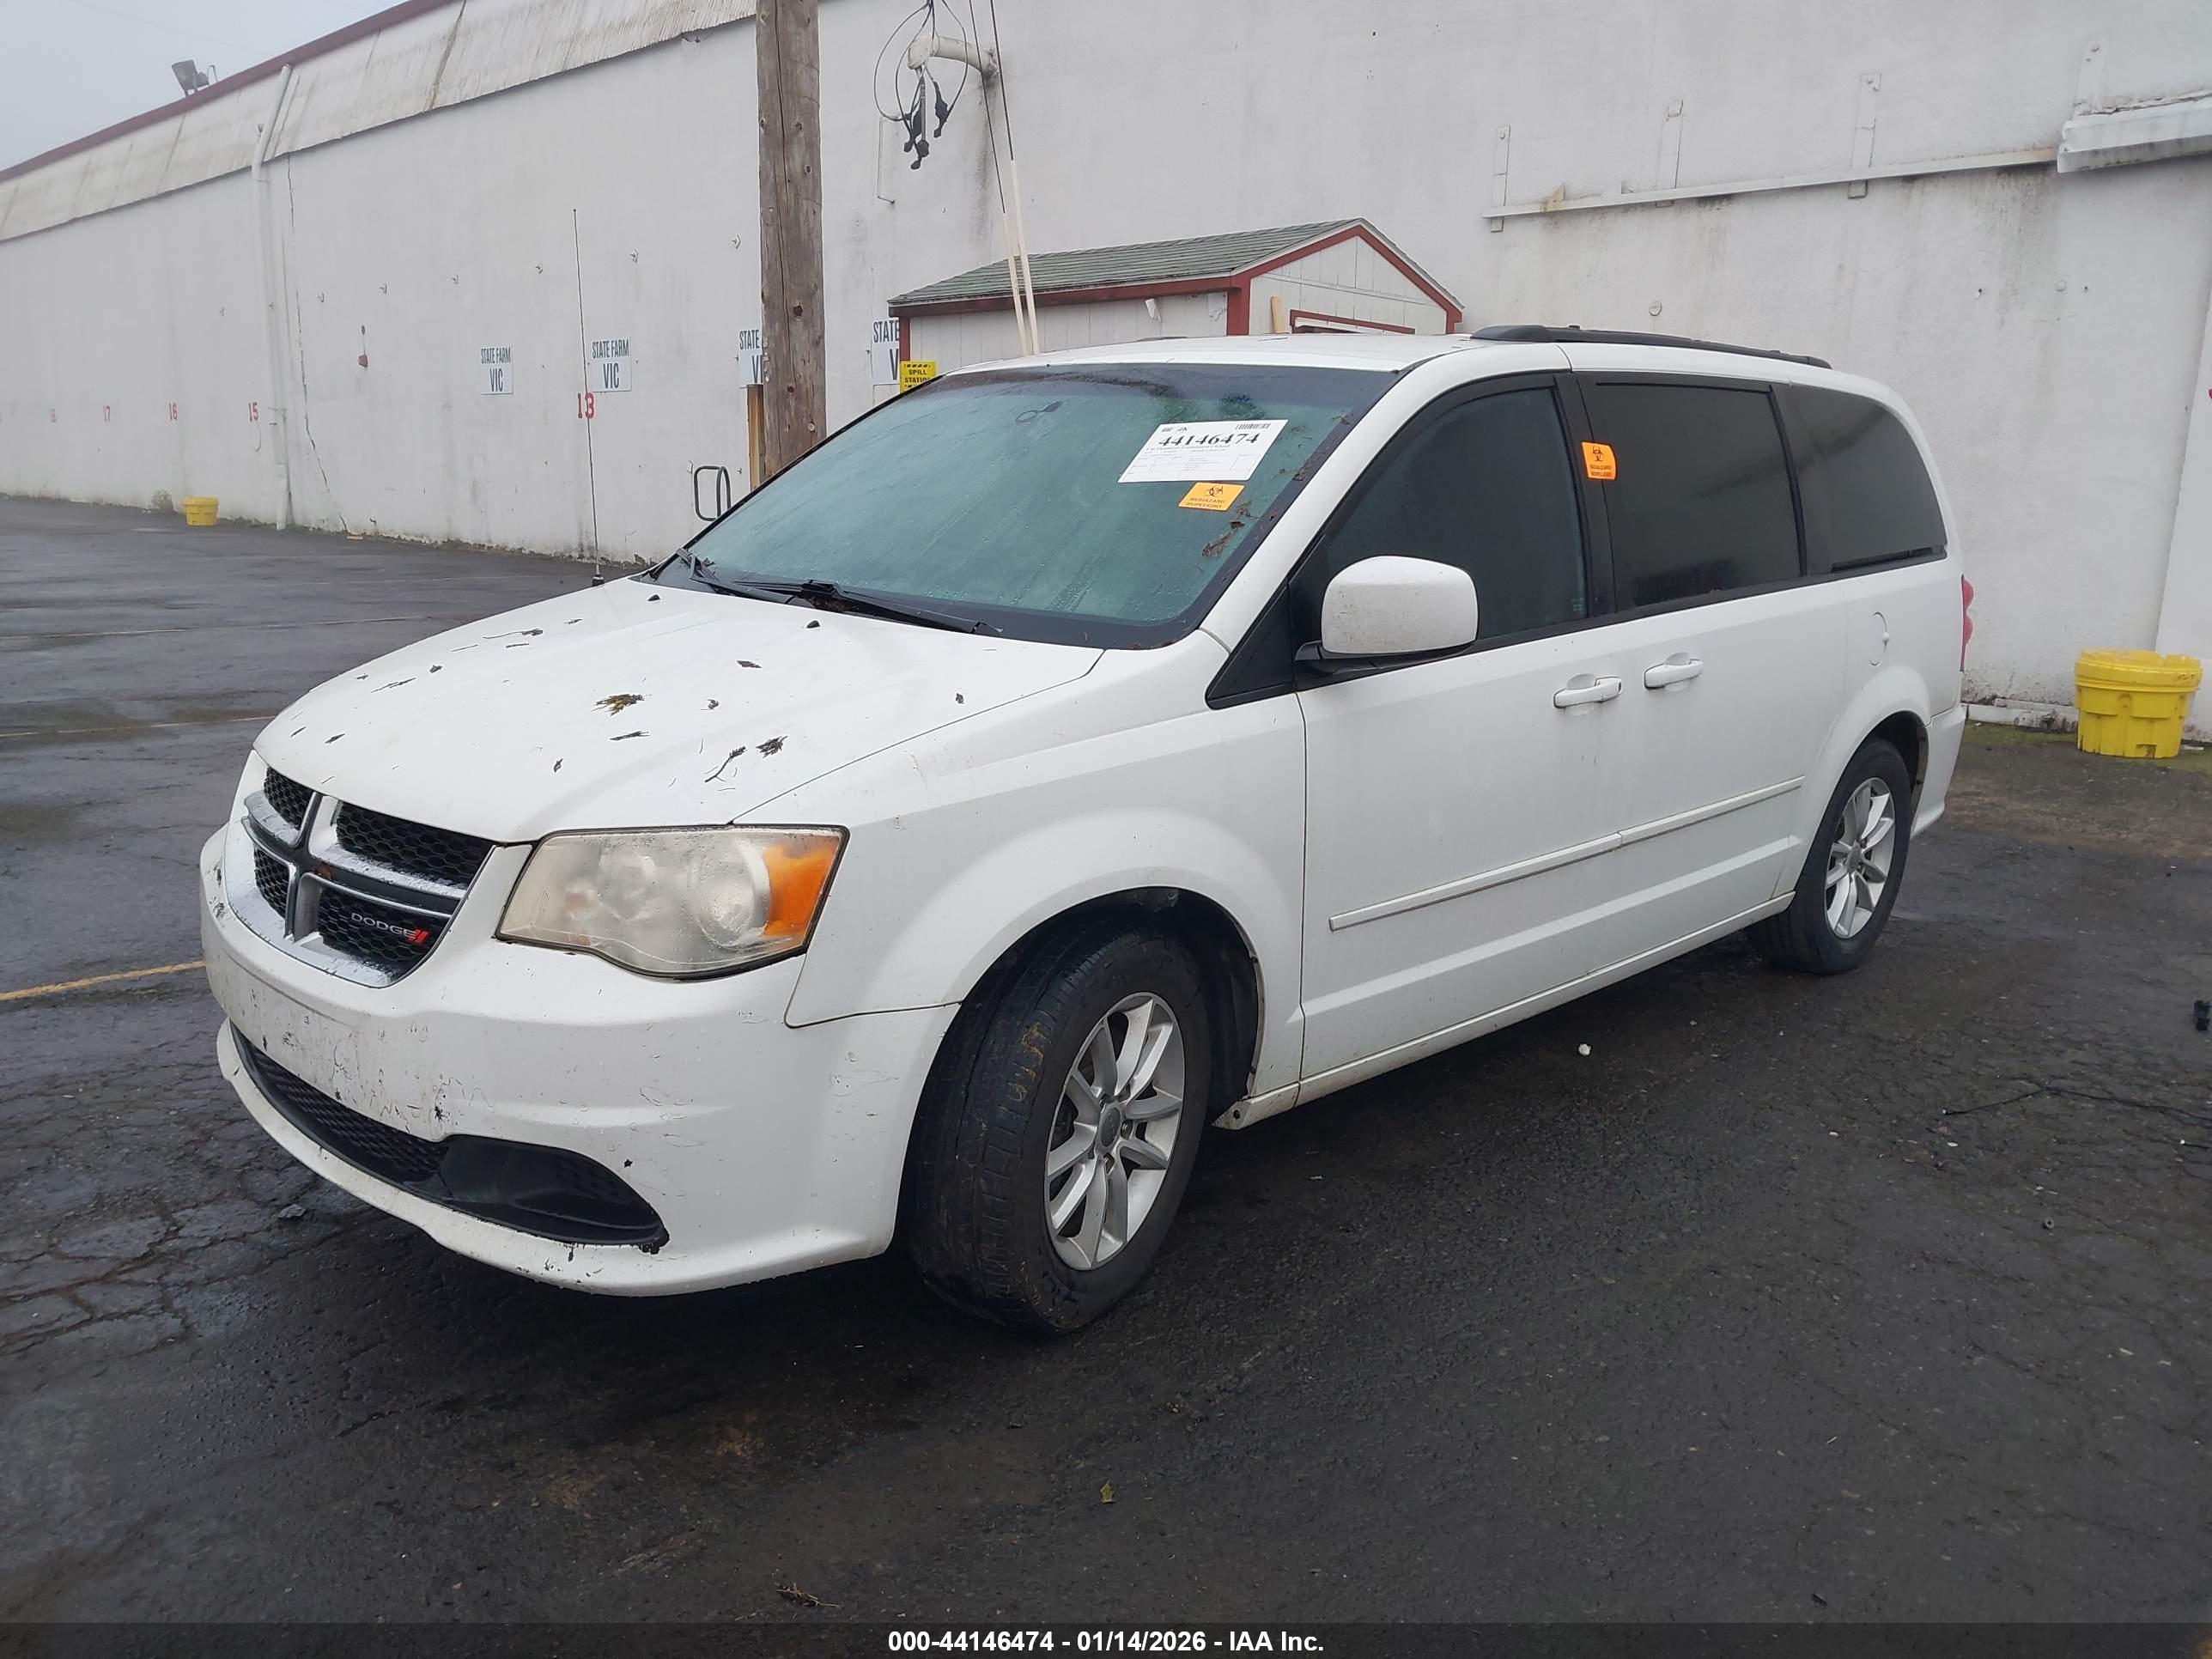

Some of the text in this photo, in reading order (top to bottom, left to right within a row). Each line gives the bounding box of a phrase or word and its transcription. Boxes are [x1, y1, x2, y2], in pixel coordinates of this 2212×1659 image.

[739, 329, 760, 350] STATE
[873, 319, 900, 343] STATE
[481, 347, 512, 364] STATE FARM
[592, 338, 629, 359] STATE FARM
[489, 368, 503, 392] VIC
[603, 362, 620, 389] VIC
[751, 355, 763, 384] VI
[248, 402, 259, 422] 15
[577, 392, 595, 419] 13
[1158, 432, 1261, 447] 44146474
[350, 912, 416, 940] DODGE
